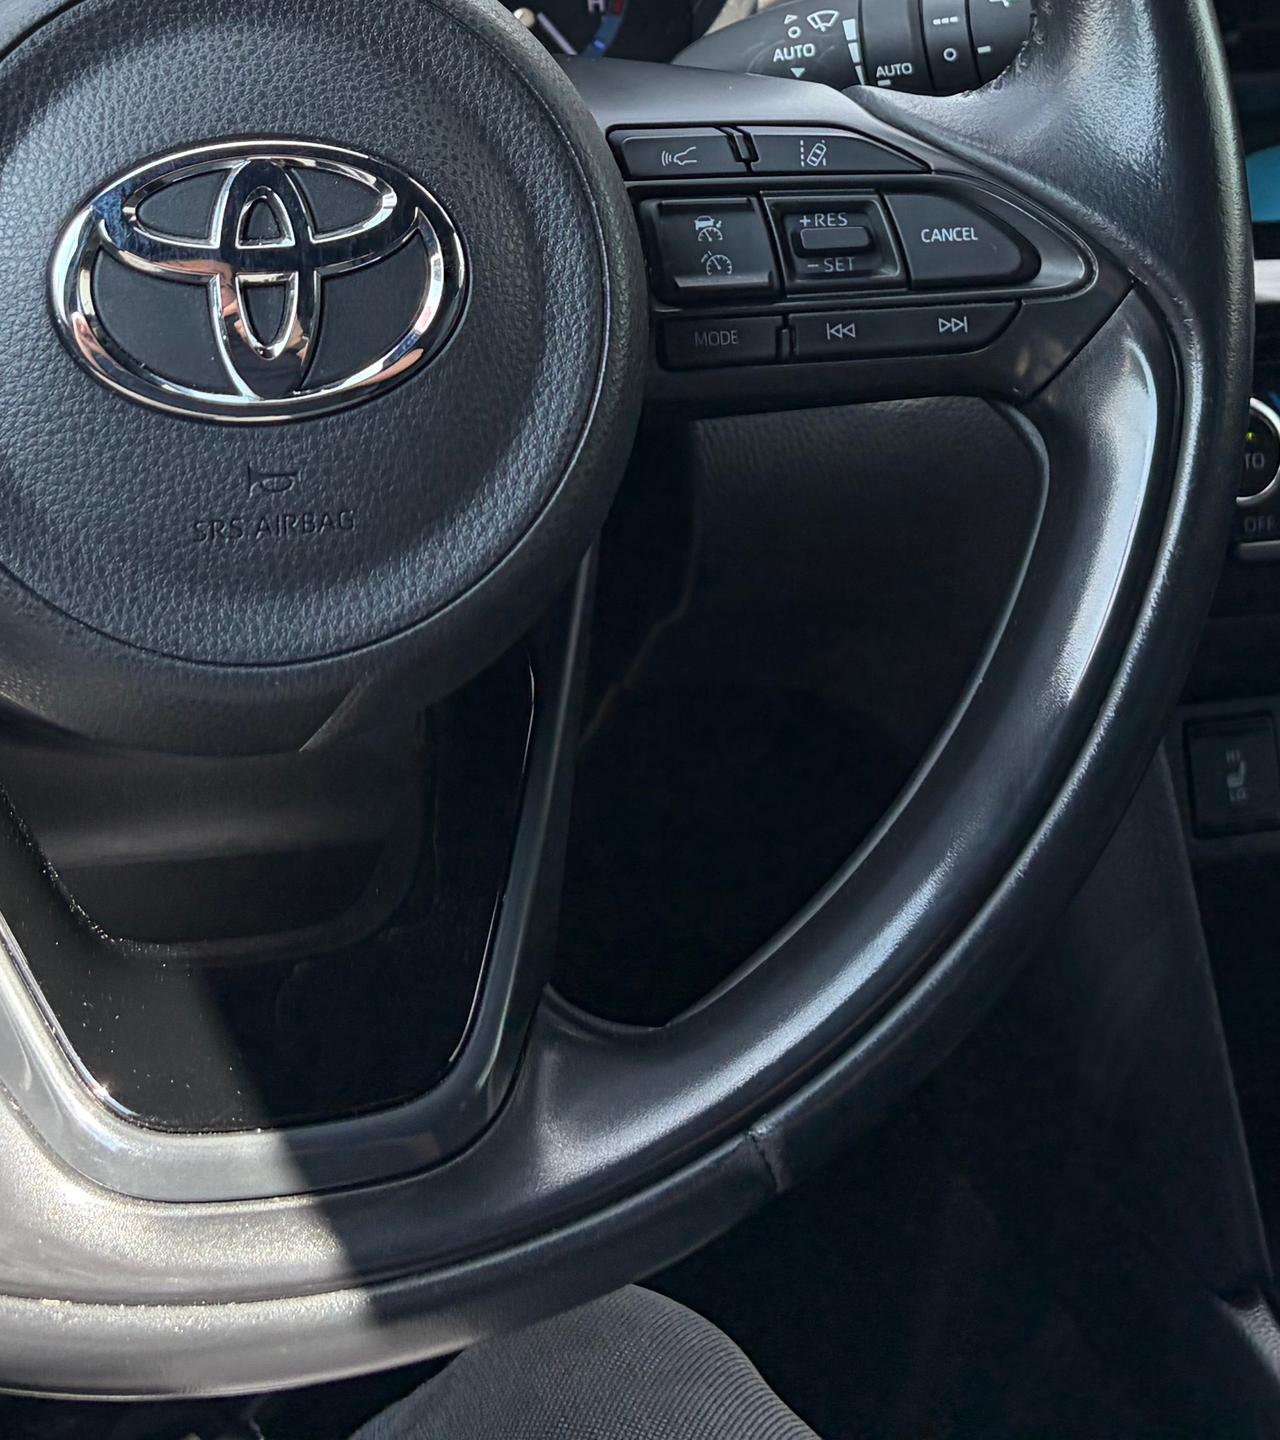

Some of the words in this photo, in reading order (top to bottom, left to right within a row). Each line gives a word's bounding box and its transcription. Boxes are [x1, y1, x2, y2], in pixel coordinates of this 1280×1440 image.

[773, 43, 815, 61] AUTO
[876, 62, 912, 77] AUTO
[921, 227, 978, 243] CANCEL
[694, 330, 739, 346] MODE
[192, 517, 243, 543] SRS
[255, 509, 356, 537] AIRBAG
